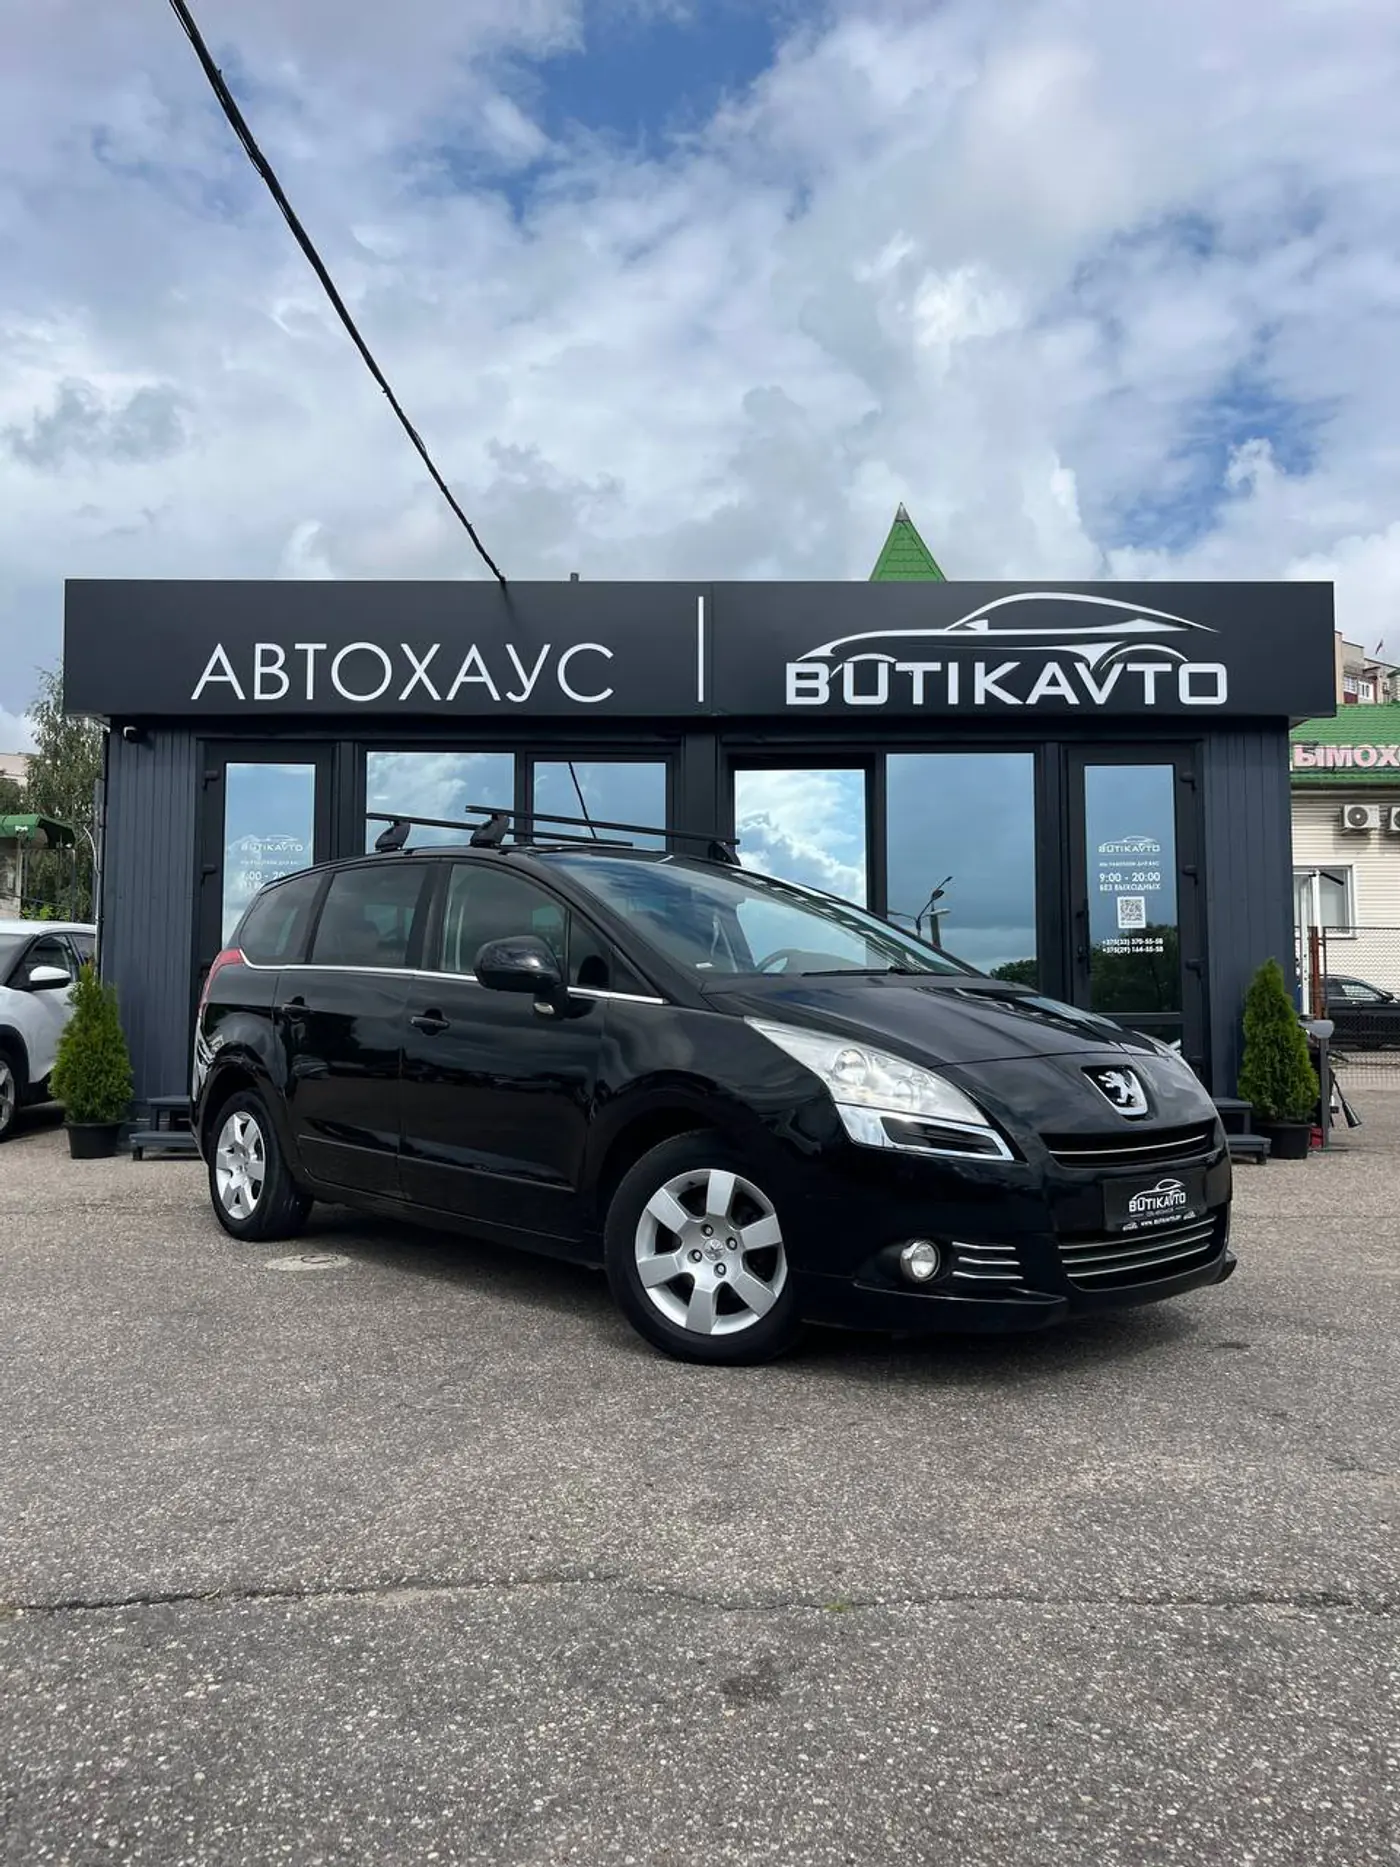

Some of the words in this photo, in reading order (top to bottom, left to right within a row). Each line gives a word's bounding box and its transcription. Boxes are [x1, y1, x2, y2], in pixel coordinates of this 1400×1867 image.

[191, 641, 614, 703] АВТОХАУС
[786, 661, 1228, 705] BUTIKAVTO
[1290, 744, 1400, 770] ЫМОХ
[1099, 872, 1121, 882] 9:00
[1131, 872, 1161, 882] 20:00
[1114, 883, 1161, 891] ВЫХОДНЫХ
[1129, 1192, 1186, 1212] BUTIKAVTO
